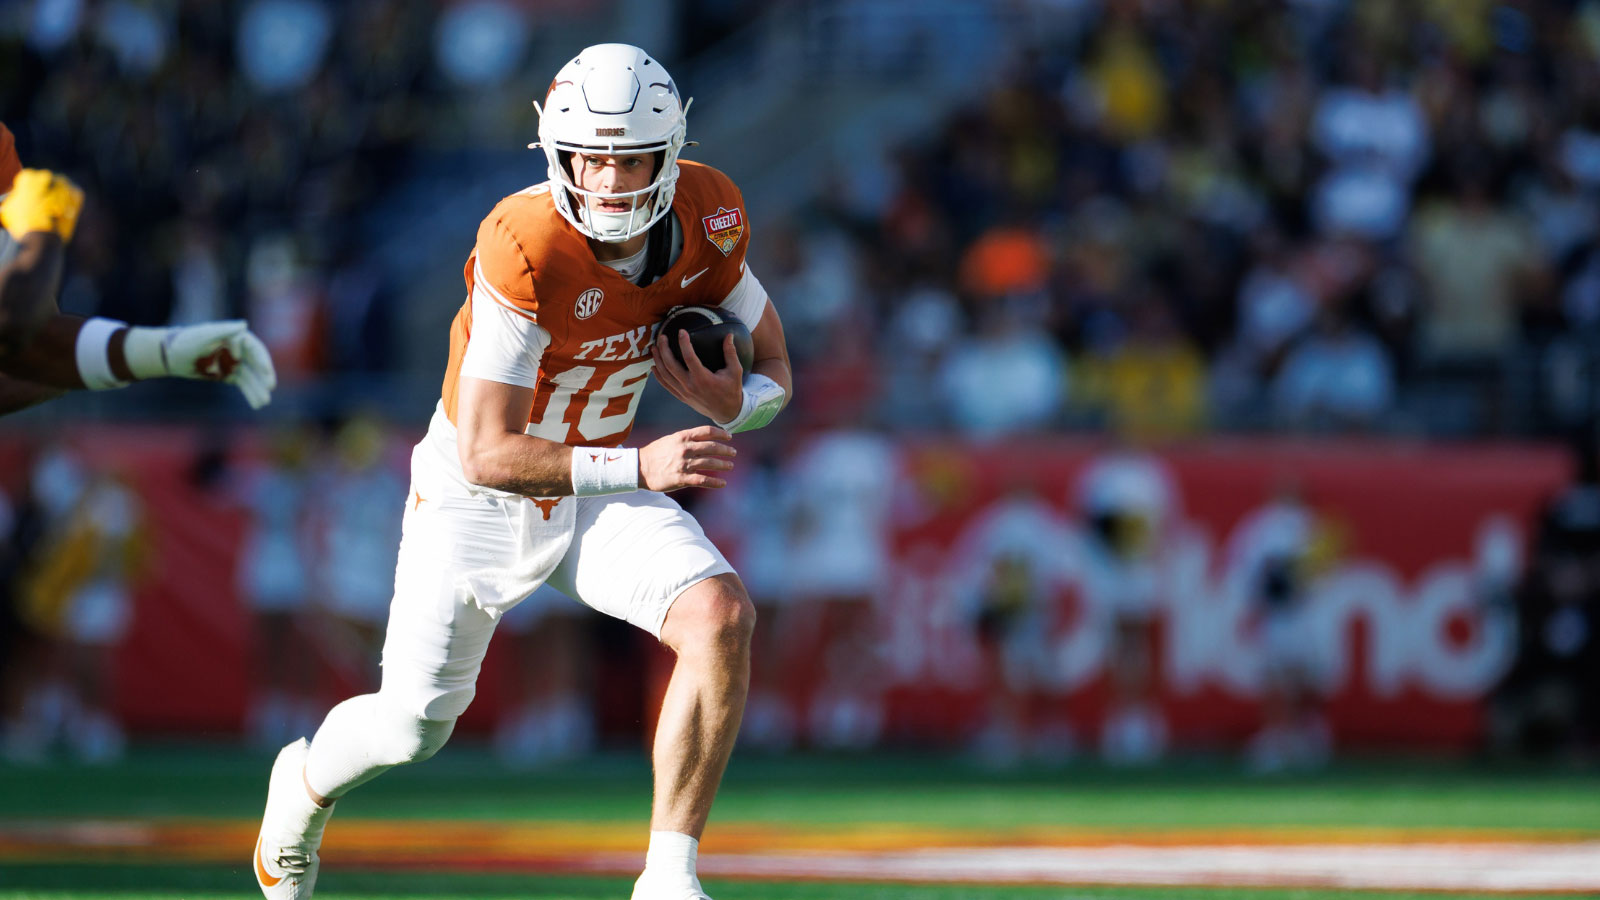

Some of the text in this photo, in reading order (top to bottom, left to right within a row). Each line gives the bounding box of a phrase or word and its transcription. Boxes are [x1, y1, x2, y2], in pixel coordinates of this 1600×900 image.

[595, 128, 625, 136] HORNS
[578, 290, 601, 318] SEC
[573, 322, 661, 361] TEX
[524, 357, 655, 443] 16
